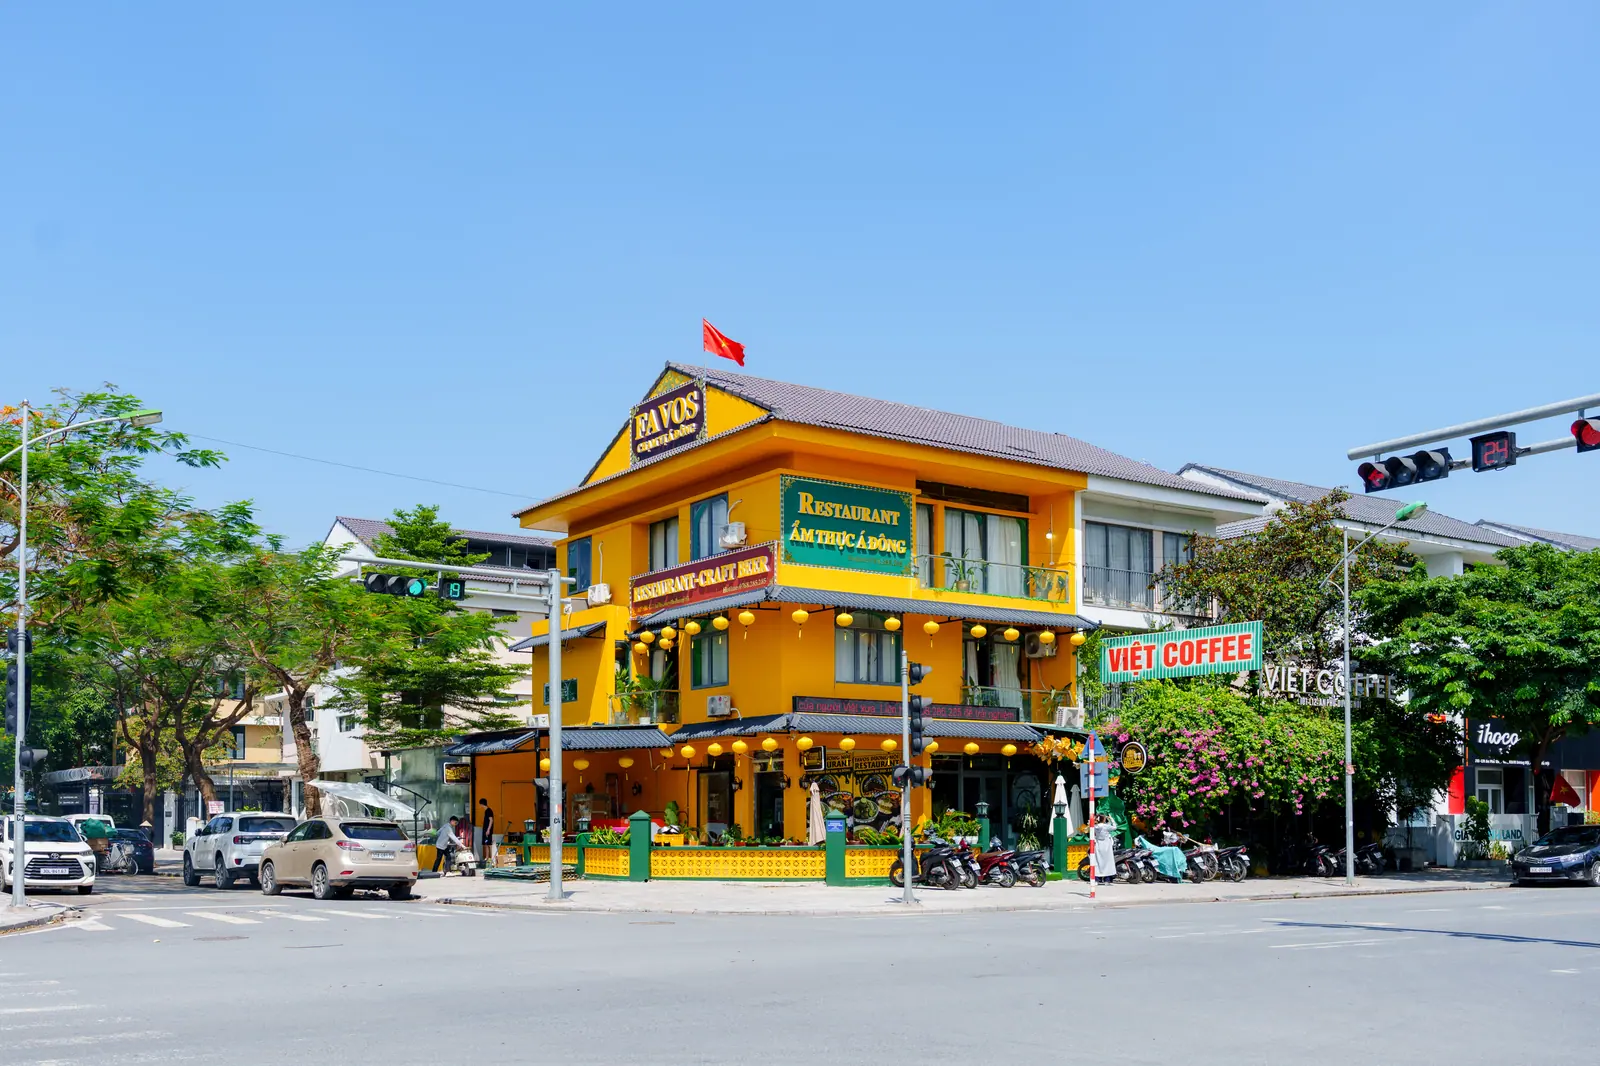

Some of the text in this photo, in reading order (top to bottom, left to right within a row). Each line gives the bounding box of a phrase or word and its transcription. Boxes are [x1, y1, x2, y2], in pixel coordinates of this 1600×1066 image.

[634, 390, 700, 441] FAVOS
[1483, 440, 1508, 465] 24
[789, 519, 907, 554] ẨM THỰC Á ĐÔNG
[737, 555, 770, 579] BEER
[1108, 633, 1253, 677] VIỆT COFFEE
[1502, 829, 1522, 840] LAND
